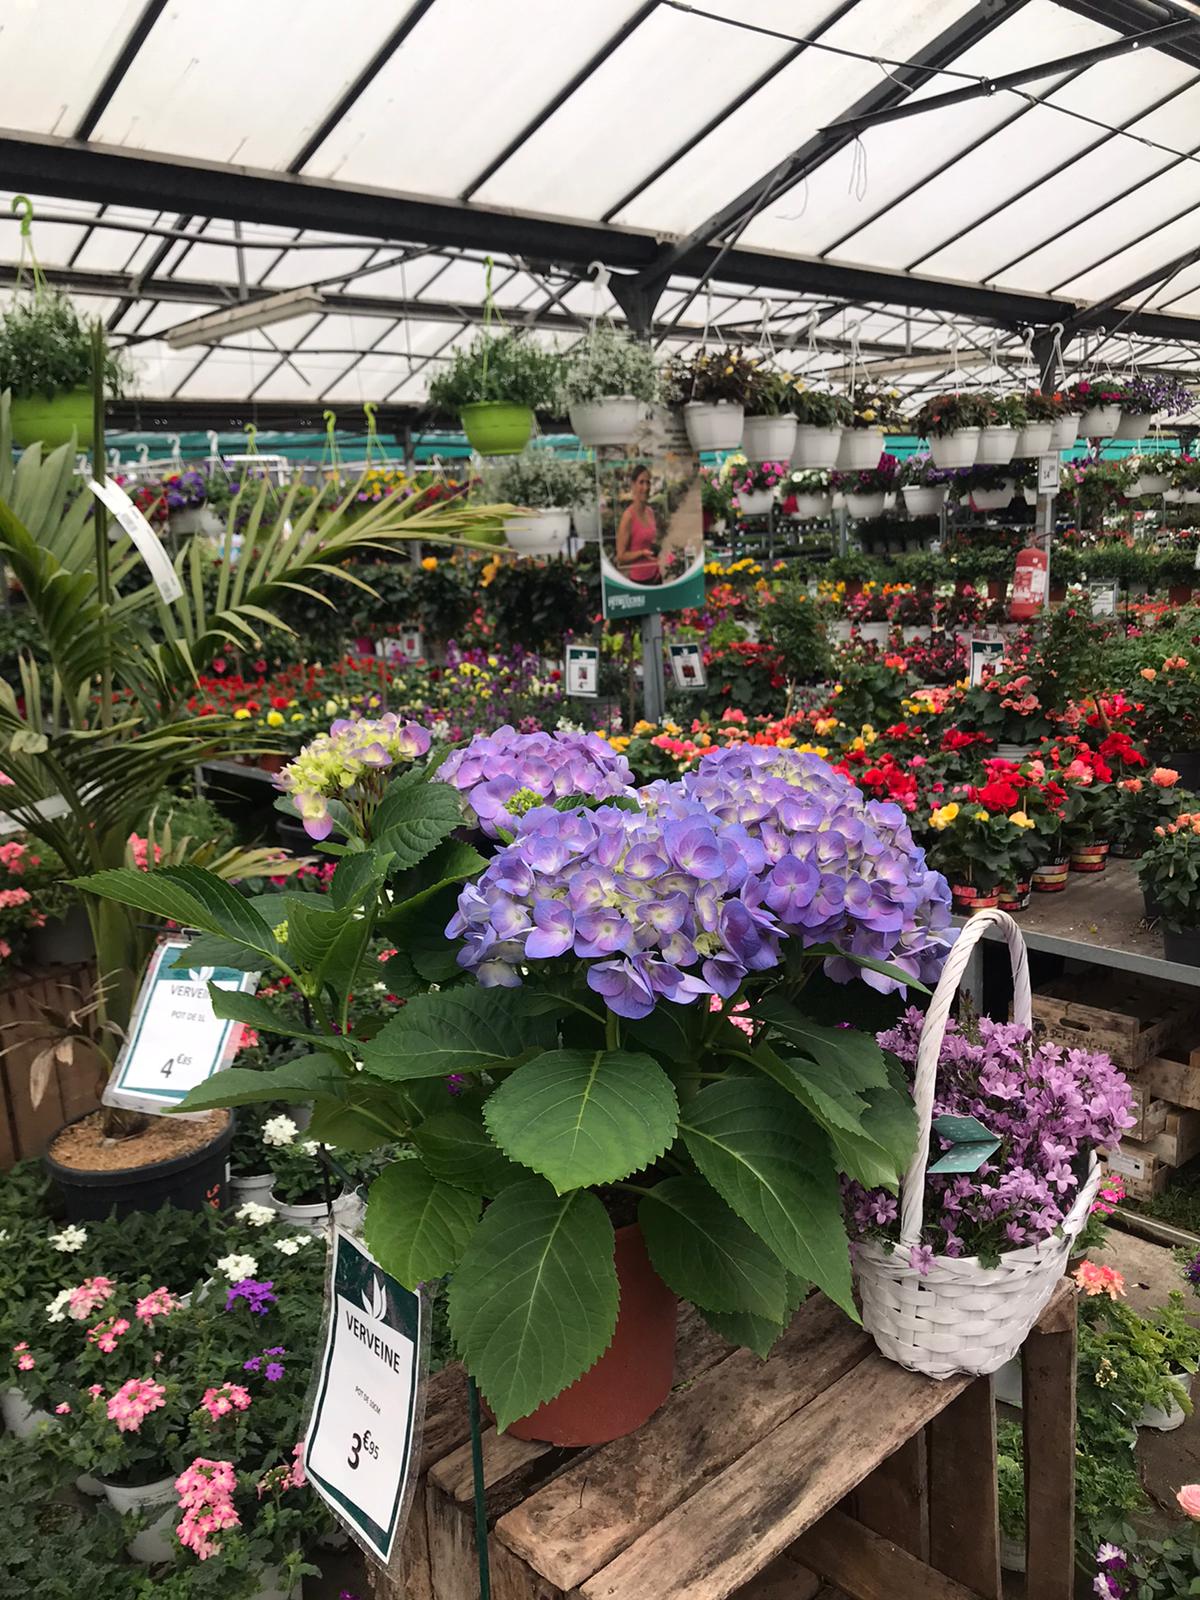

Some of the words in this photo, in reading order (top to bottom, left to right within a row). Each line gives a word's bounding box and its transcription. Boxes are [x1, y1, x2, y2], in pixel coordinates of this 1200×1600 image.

[171, 1010, 186, 1019] POT
[187, 1012, 197, 1021] DE
[346, 1311, 400, 1374] VERVEINE
[355, 1385, 364, 1397] POT
